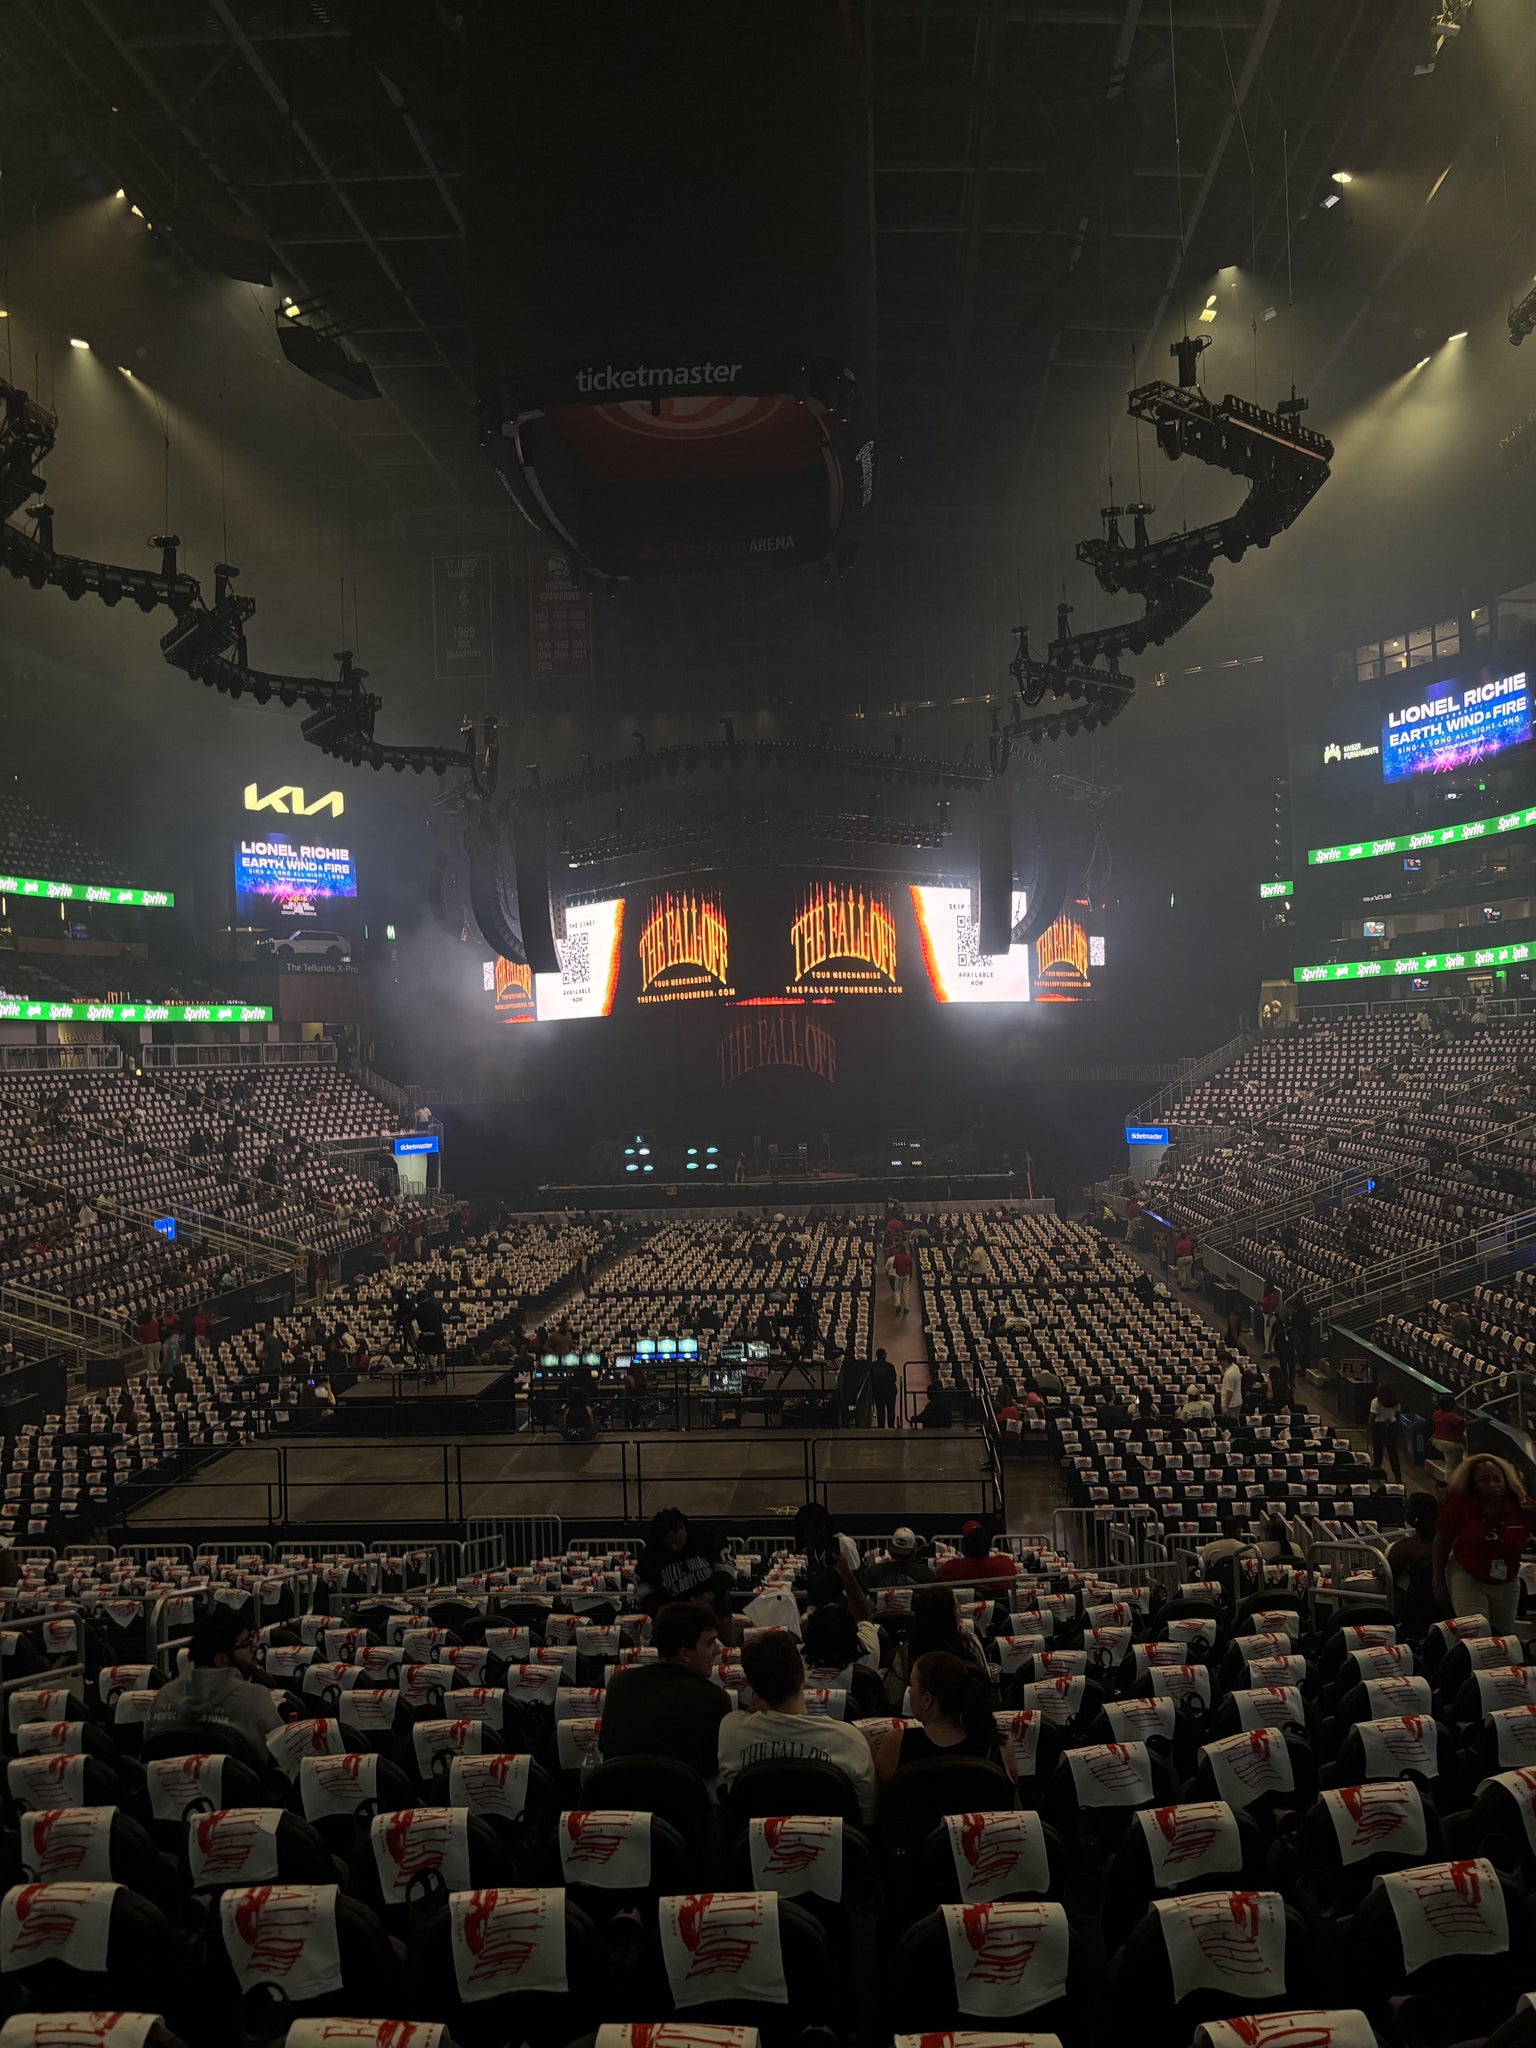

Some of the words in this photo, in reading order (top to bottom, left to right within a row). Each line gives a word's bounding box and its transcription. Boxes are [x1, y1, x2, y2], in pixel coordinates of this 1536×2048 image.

[576, 361, 742, 393] ticketmaster
[749, 535, 795, 553] ARENA
[1389, 696, 1460, 729] LIONEL
[1463, 672, 1526, 708] RICHIE
[1389, 723, 1445, 747] EARTH,
[1445, 712, 1485, 733] WIND
[1485, 711, 1492, 720] &
[1493, 696, 1526, 719] FIRE
[1397, 744, 1417, 755] SING
[1429, 737, 1452, 747] SONG
[1455, 732, 1469, 740] ALL
[1472, 723, 1495, 735] NIGHT
[1499, 716, 1520, 728] LONG
[1461, 823, 1484, 838] Sprite
[1498, 815, 1520, 831] Sprite
[1409, 833, 1434, 848] Sprite
[241, 841, 297, 857] LIONEL
[301, 846, 349, 861] RICHIE
[1316, 848, 1341, 863] Sprite
[1372, 841, 1396, 856] Sprite
[286, 860, 318, 871] WIND
[324, 863, 349, 874] FIRE
[47, 884, 72, 898] Sprite
[86, 887, 111, 901] Sprite
[142, 892, 167, 906] Sprite
[791, 906, 826, 982] THE
[827, 895, 896, 983] FALL-OFF
[640, 908, 665, 992] THE
[666, 902, 728, 985] FALL-OFF
[1036, 926, 1053, 979] THE
[1512, 945, 1528, 960] Sprite
[1445, 954, 1464, 969] Sprite
[1475, 950, 1494, 965] Sprite
[287, 963, 301, 971] The
[304, 963, 336, 972] Telluride
[337, 964, 359, 973] X-Pro
[1357, 963, 1380, 977] Sprite
[1394, 959, 1419, 974] Sprite
[654, 979, 669, 988] TOUR
[671, 975, 712, 987] MERCHANDISE
[812, 971, 830, 979] TOUR
[833, 971, 881, 979] MERCHANDISE
[1301, 967, 1327, 982] Sprite
[563, 988, 591, 996] AVAILABLE
[0, 1004, 20, 1017] prite
[49, 1005, 73, 1019] Sprite
[87, 1005, 114, 1020] Sprite
[144, 1006, 169, 1020] Sprite
[184, 1006, 210, 1020] Sprite
[240, 1007, 265, 1021] Sprite
[64, 1032, 101, 1042] HAWKS
[717, 1022, 754, 1089] THE
[757, 1014, 837, 1084] FALL-OFF
[1131, 1132, 1163, 1140] ticketmaster
[400, 1143, 433, 1151] ticketmaster
[1343, 1363, 1356, 1374] FL
[1360, 1363, 1367, 1374] 7
[208, 1715, 230, 1724] TOUR
[740, 1742, 767, 1768] THE
